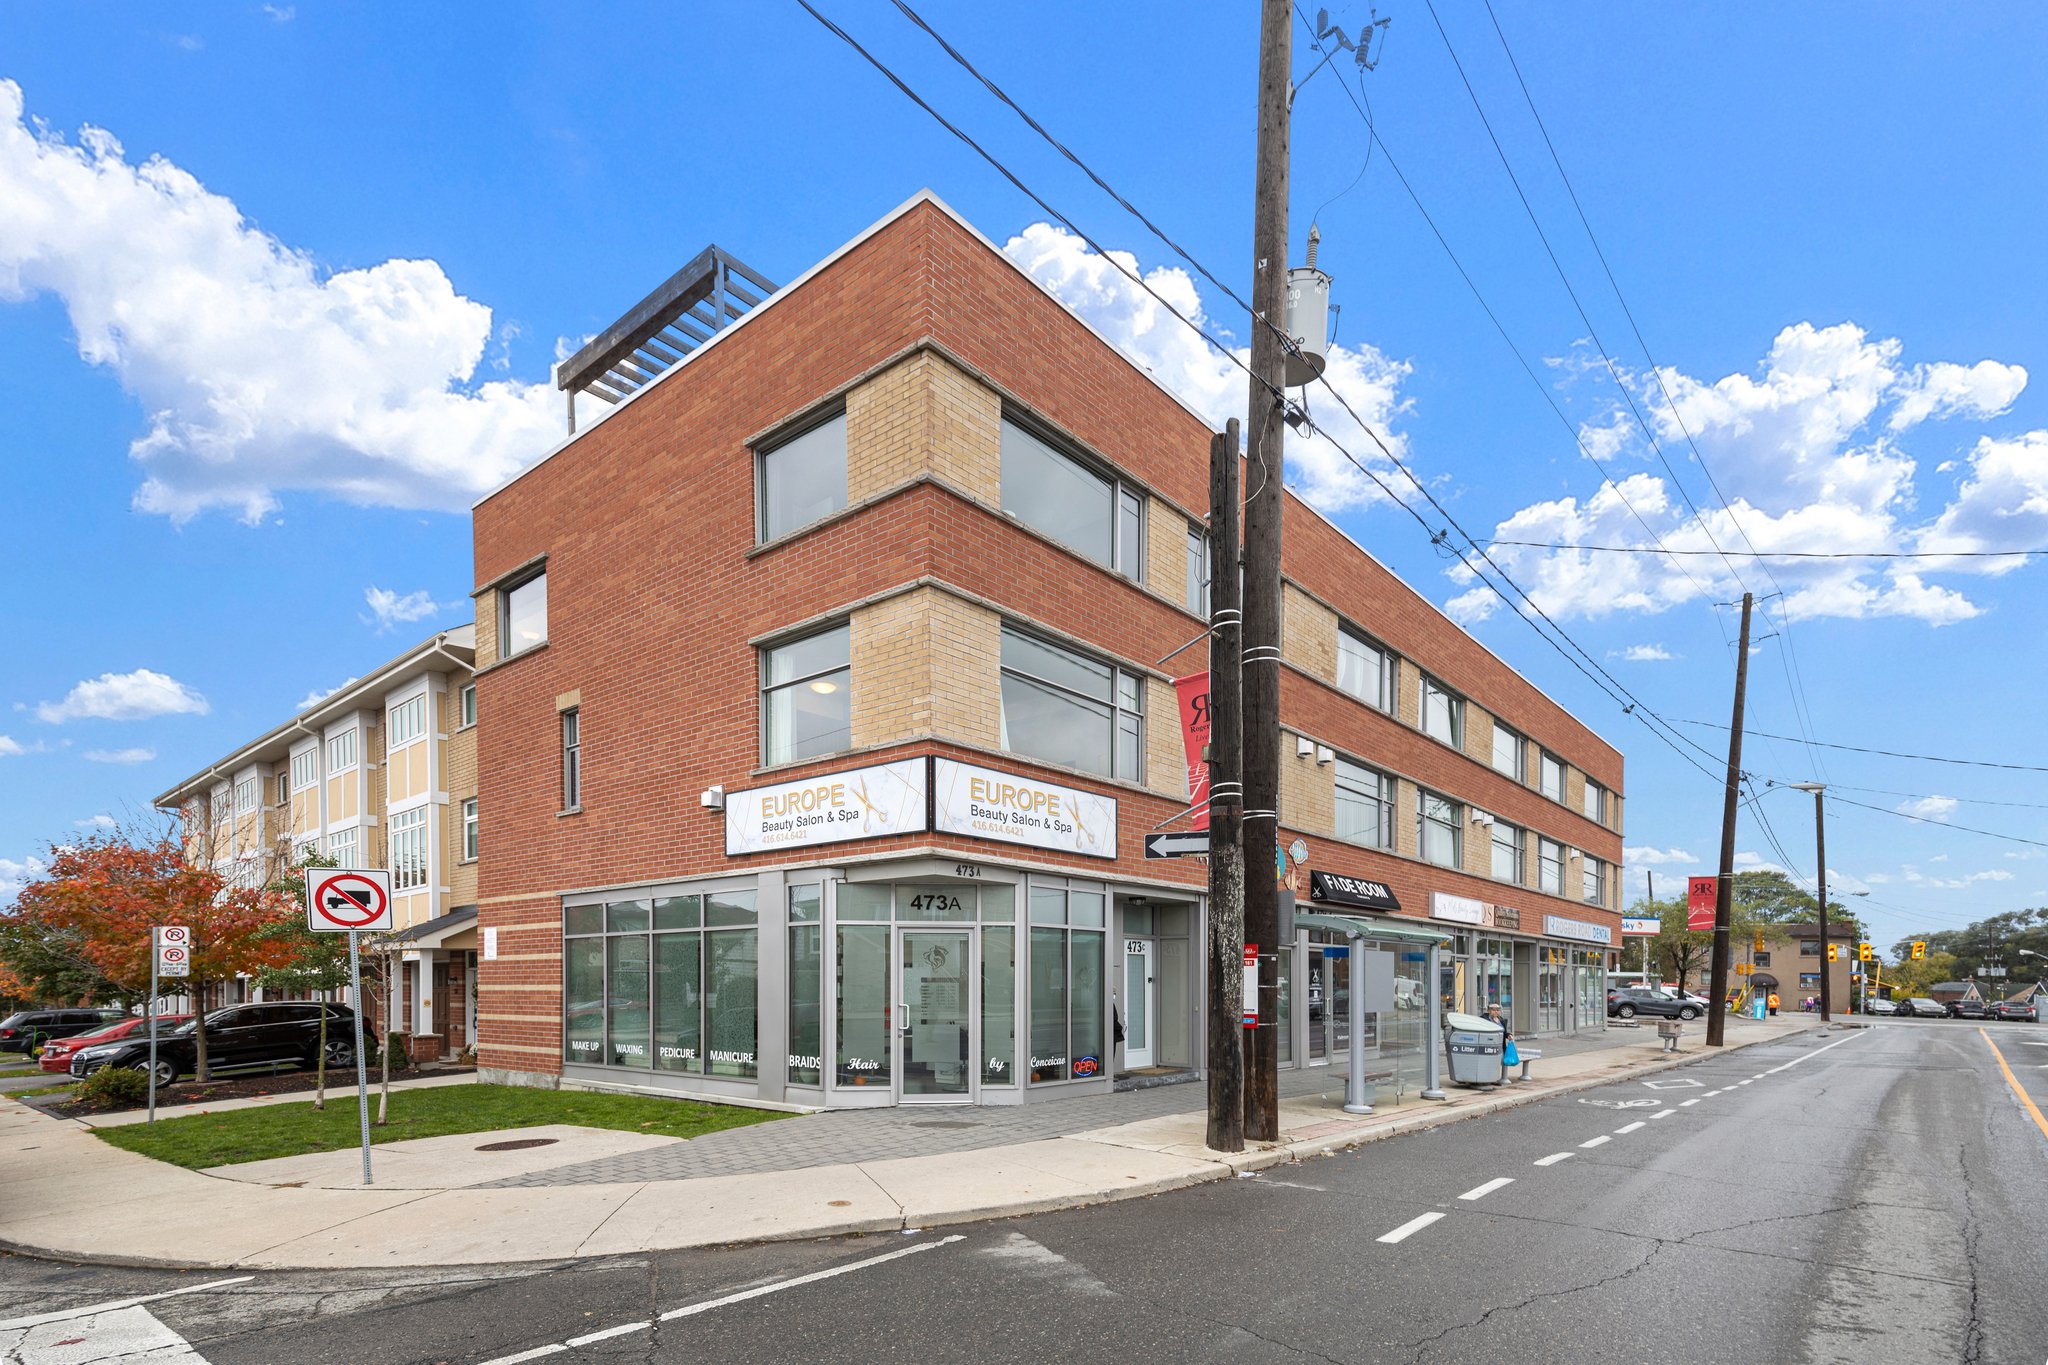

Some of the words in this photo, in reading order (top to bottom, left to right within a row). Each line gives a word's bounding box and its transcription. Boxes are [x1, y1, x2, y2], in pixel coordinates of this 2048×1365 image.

[1190, 723, 1211, 734] Roger
[762, 784, 845, 818] EUROPE
[970, 777, 1060, 816] EUROPE
[762, 820, 794, 833] Beauty
[796, 815, 824, 827] Salon
[827, 811, 835, 822] &
[838, 810, 859, 822] Spa
[971, 804, 1008, 824] Beauty
[1012, 812, 1041, 827] Salon
[1044, 818, 1051, 829] &
[1054, 820, 1072, 834] Spa
[972, 820, 1024, 837] 416.614.6421
[762, 830, 807, 844] 416.614.6421
[956, 864, 981, 877] 473A
[1354, 881, 1389, 898] ROOM
[910, 894, 961, 911] 473A
[1622, 921, 1634, 930] sky
[1592, 926, 1610, 941] DENTAL
[572, 1040, 591, 1051] MAKE
[590, 1042, 600, 1052] UP
[615, 1043, 643, 1055] WAXING
[660, 1046, 695, 1059] PEDICURE
[710, 1050, 754, 1063] MANICURE
[789, 1054, 821, 1069] BRAIDS
[847, 1057, 880, 1070] Hair
[989, 1056, 1005, 1072] by
[1073, 1059, 1099, 1075] OPEN
